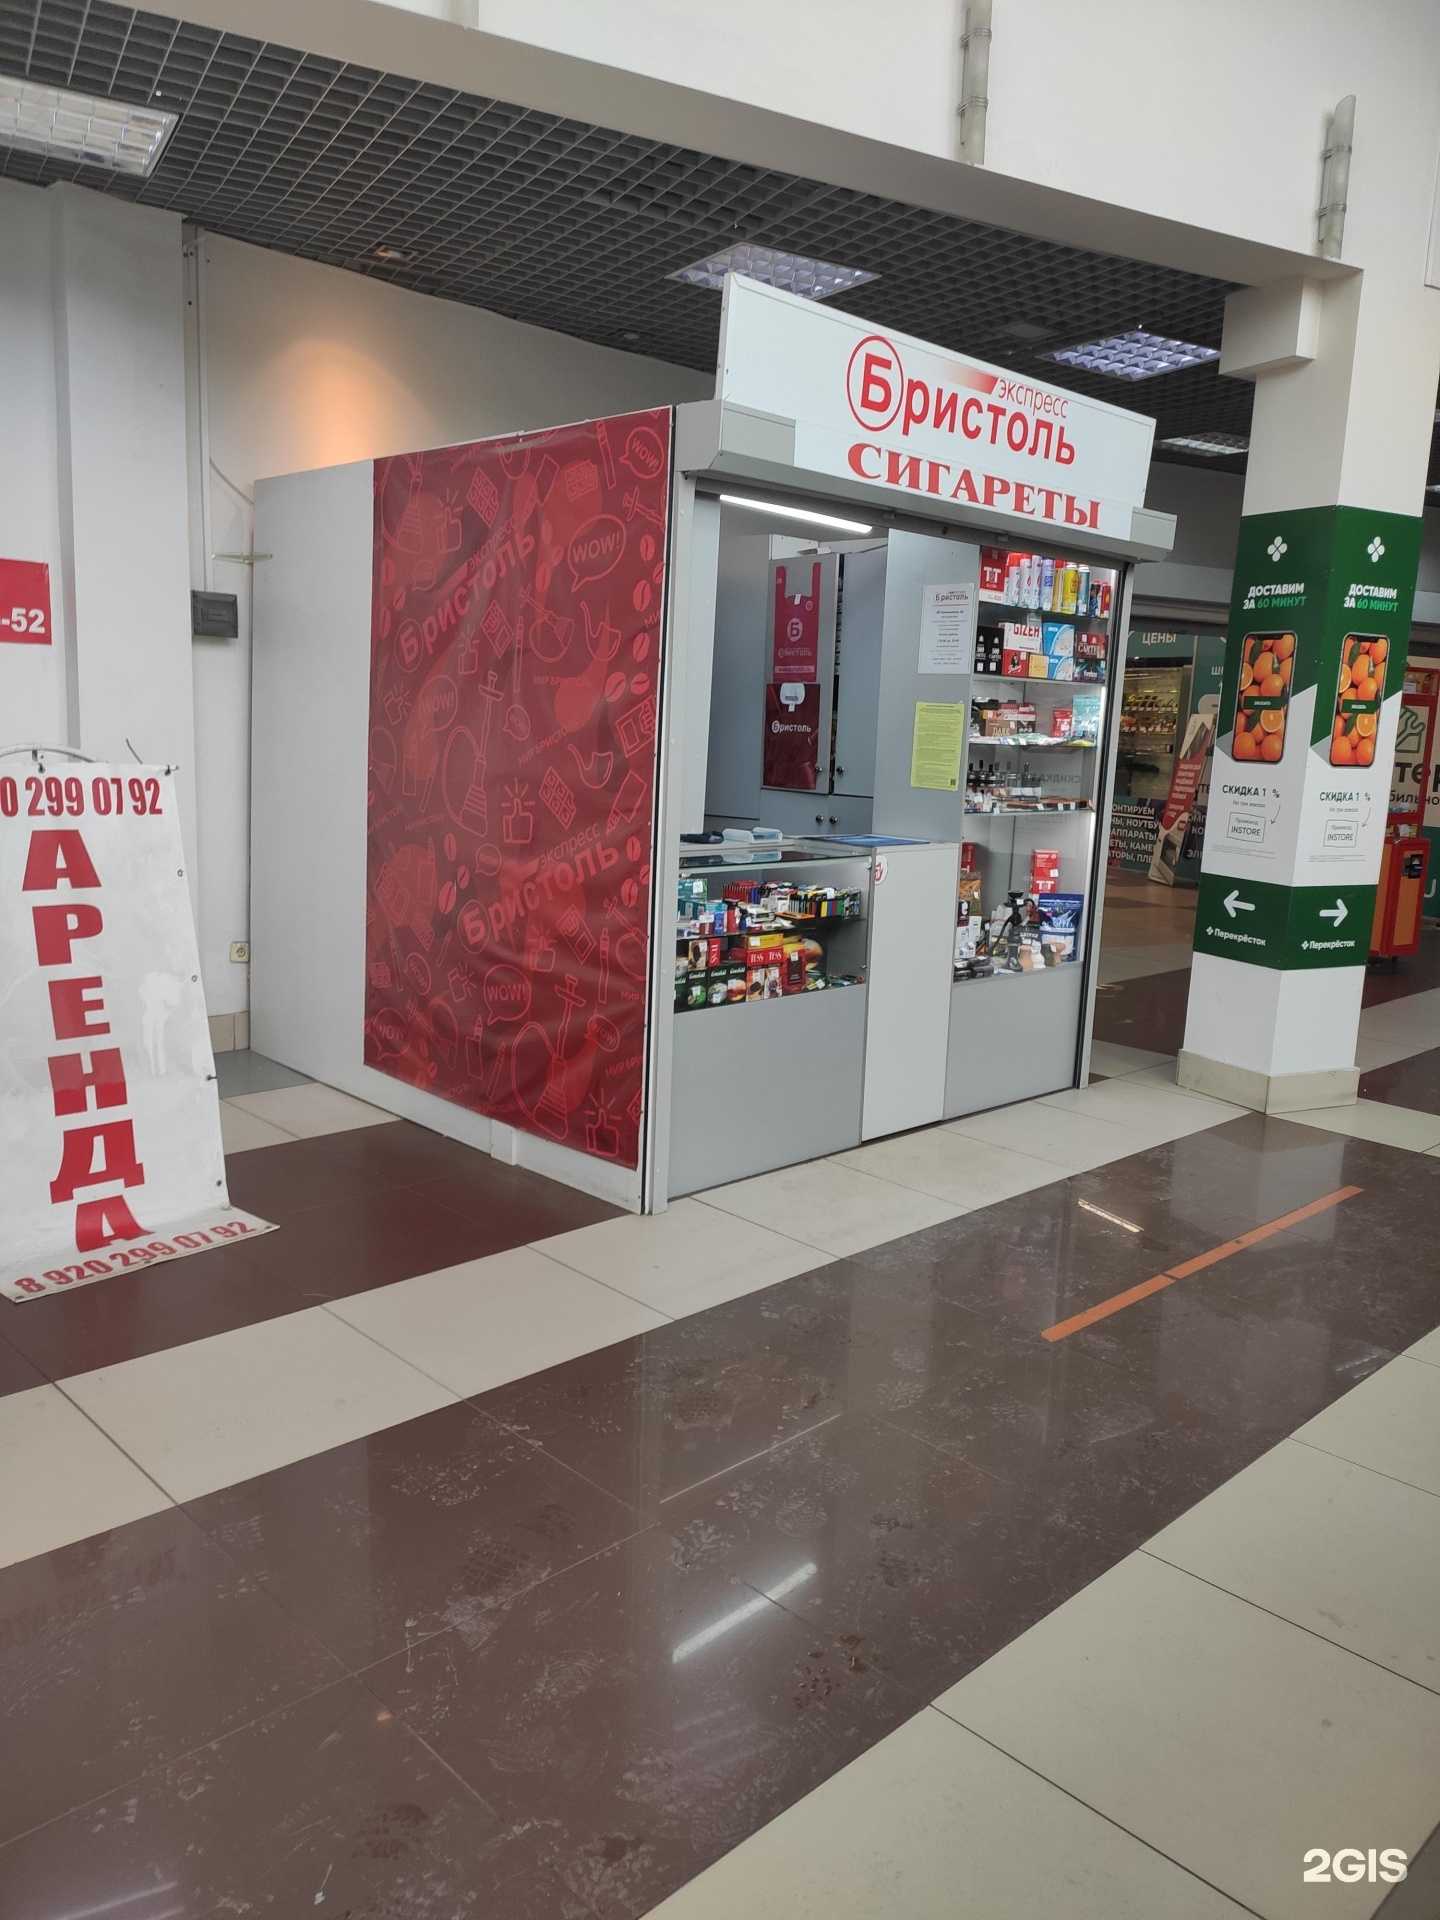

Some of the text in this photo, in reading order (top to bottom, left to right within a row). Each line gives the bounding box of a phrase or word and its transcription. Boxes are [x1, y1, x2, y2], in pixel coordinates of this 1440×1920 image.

[848, 337, 1076, 466] Бристоль
[999, 379, 1069, 418] экспресс
[631, 438, 661, 472] WOW!
[848, 443, 1101, 529] СИГАРЕТЫ
[572, 531, 621, 562] WOW!
[398, 532, 536, 668] Бристоль
[1243, 596, 1307, 609] ЗА 60 МИНУТ
[1248, 583, 1304, 598] ДОСТАВИМ
[1348, 583, 1398, 599] ДОСТАВИМ
[1343, 597, 1399, 612] ЗА 60 МИНУТ
[1142, 632, 1177, 646] ЦЕНЫ
[25, 777, 86, 817] 299
[92, 778, 124, 816] 07
[128, 778, 163, 816] 92
[1222, 784, 1260, 798] СКИДКА
[1319, 791, 1353, 802] СКИДКА
[1231, 825, 1261, 837] INSTORE
[1327, 833, 1354, 841] INSTORE
[539, 823, 601, 867] экспресс
[457, 842, 619, 952] Бристоль
[1214, 928, 1266, 946] Перекрёсток
[487, 983, 525, 1000] WOW!
[22, 829, 155, 1253] АРЕНДА
[14, 1221, 257, 1293] 8 920 299 07 92
